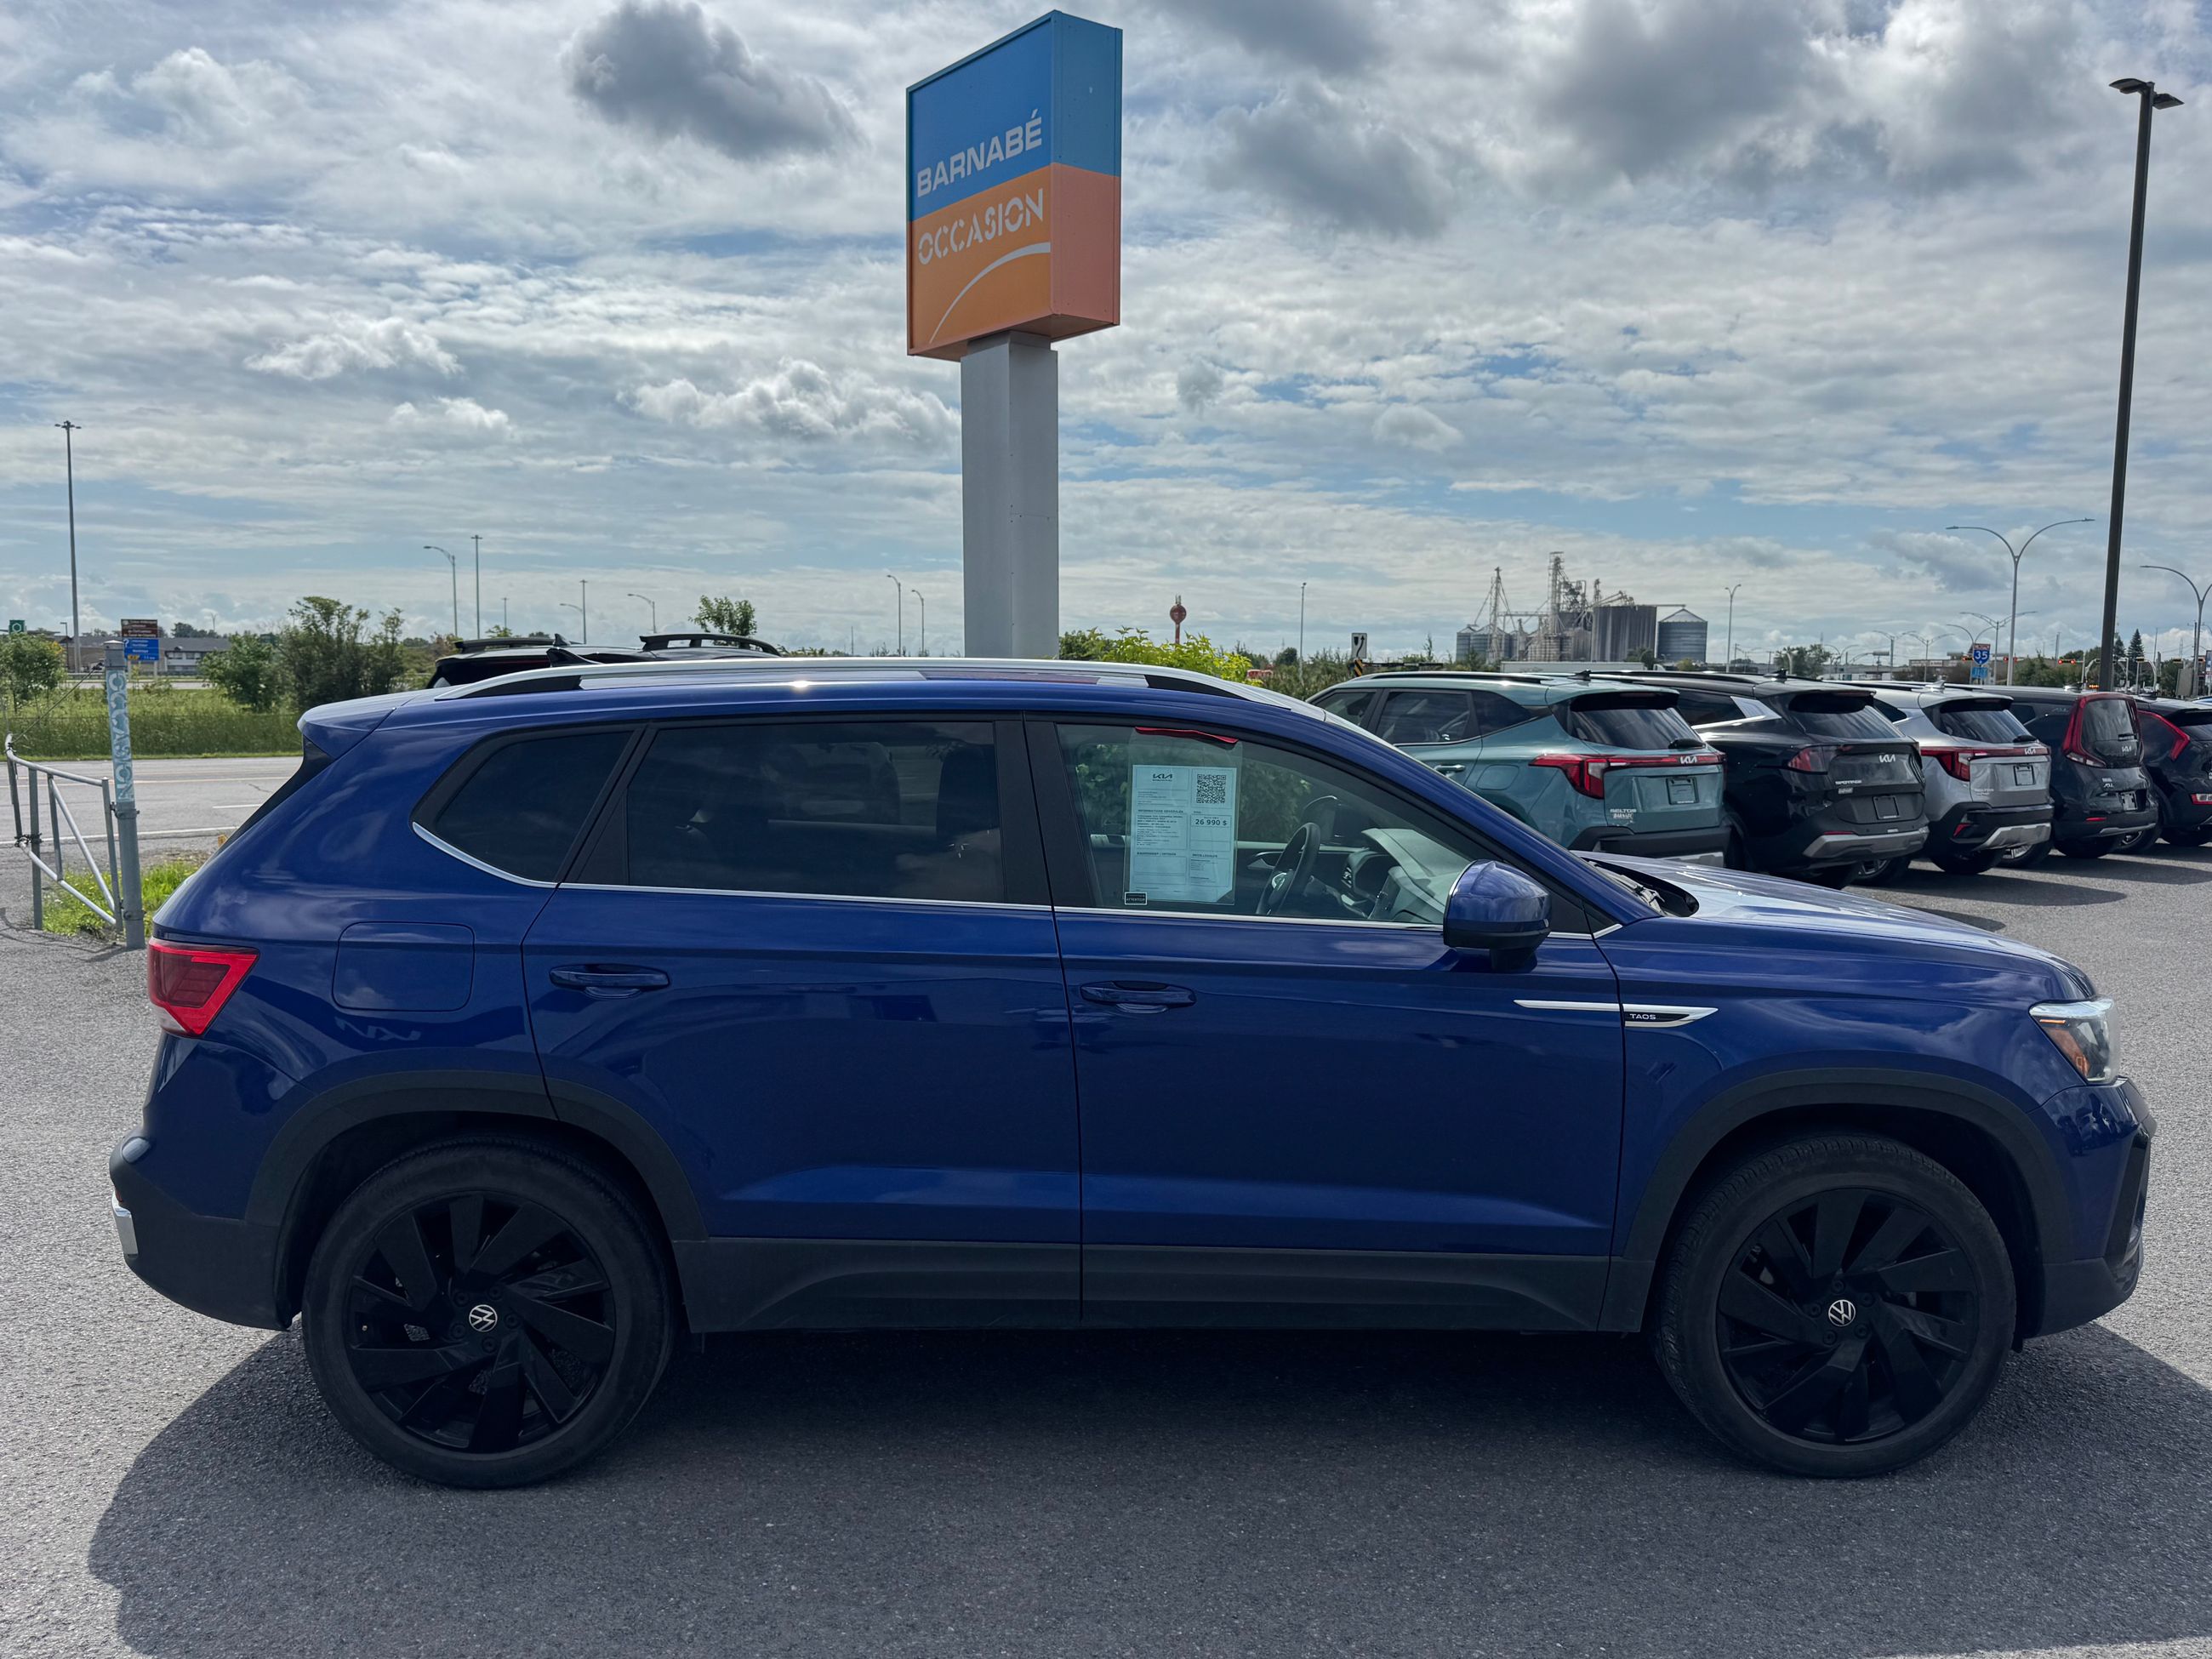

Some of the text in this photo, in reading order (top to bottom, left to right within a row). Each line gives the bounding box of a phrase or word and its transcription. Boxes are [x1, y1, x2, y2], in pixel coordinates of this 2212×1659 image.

[917, 109, 1042, 198] BARNABÉ
[918, 188, 1043, 265] OCCASION
[1975, 650, 1988, 660] 35
[1679, 755, 1697, 764] KIA
[1878, 754, 1896, 763] KIA
